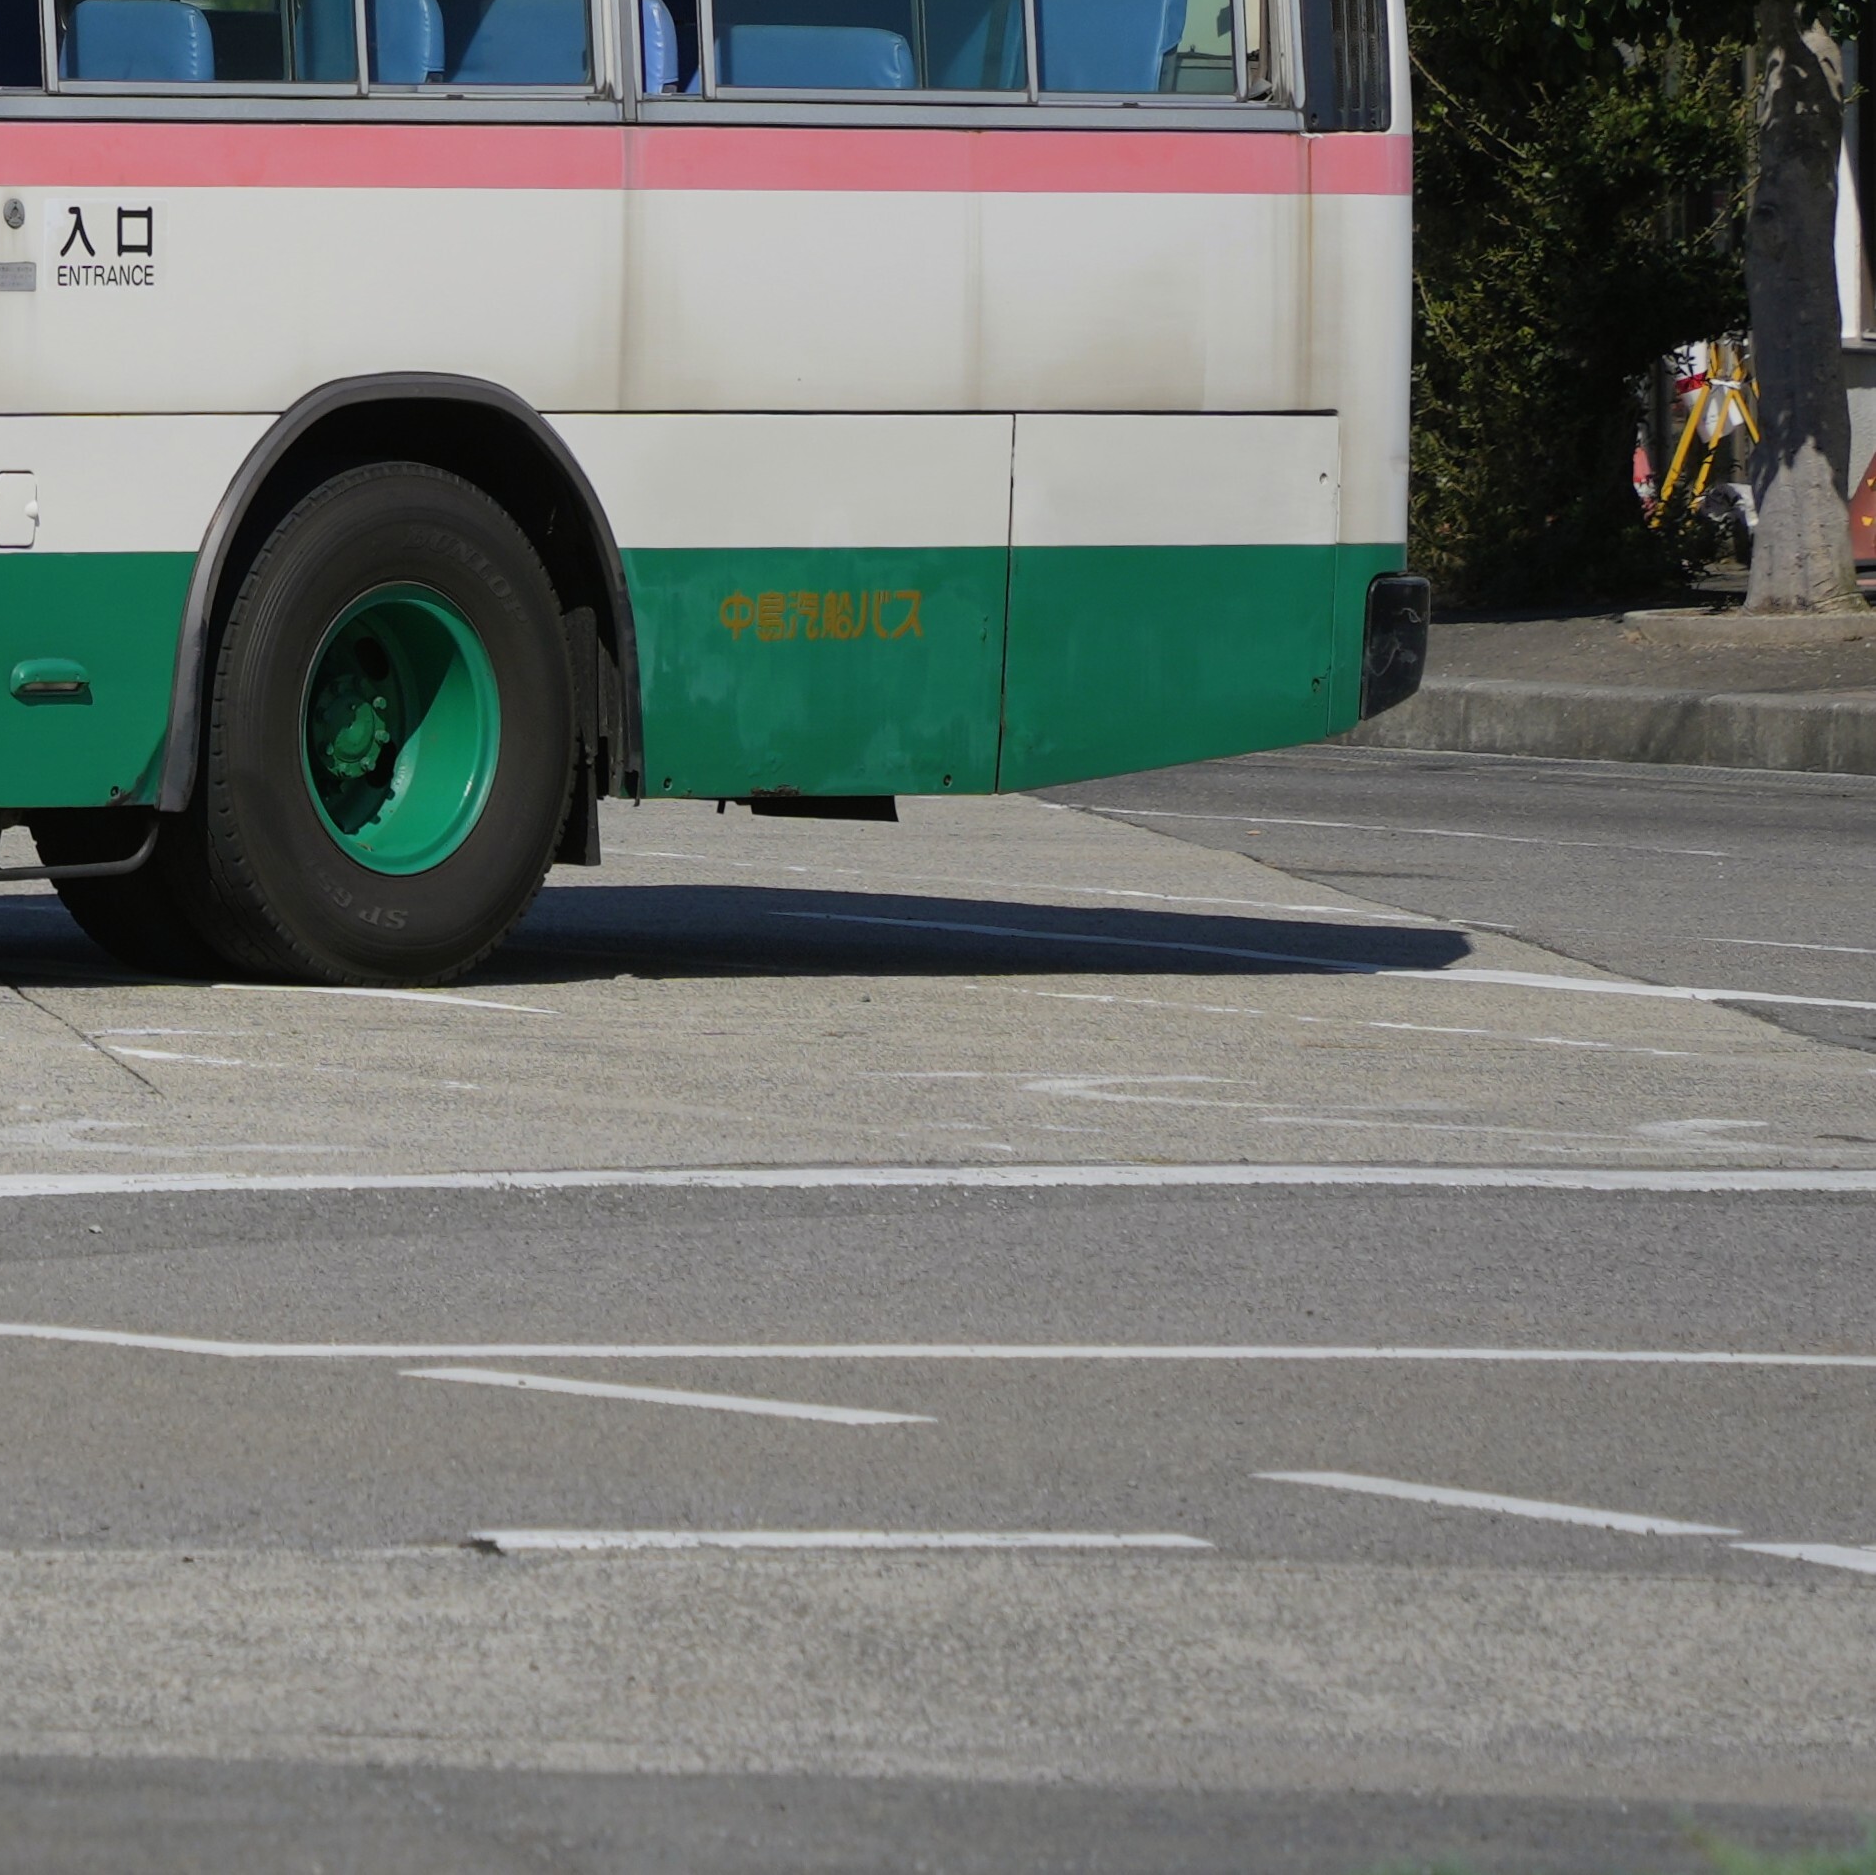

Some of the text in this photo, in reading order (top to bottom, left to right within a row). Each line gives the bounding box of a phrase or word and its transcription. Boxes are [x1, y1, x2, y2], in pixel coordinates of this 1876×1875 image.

[60, 206, 153, 257] 入口
[57, 265, 155, 286] ENTRANCE
[401, 524, 529, 623] DUNLOP
[719, 589, 925, 642] 中島汽船バス
